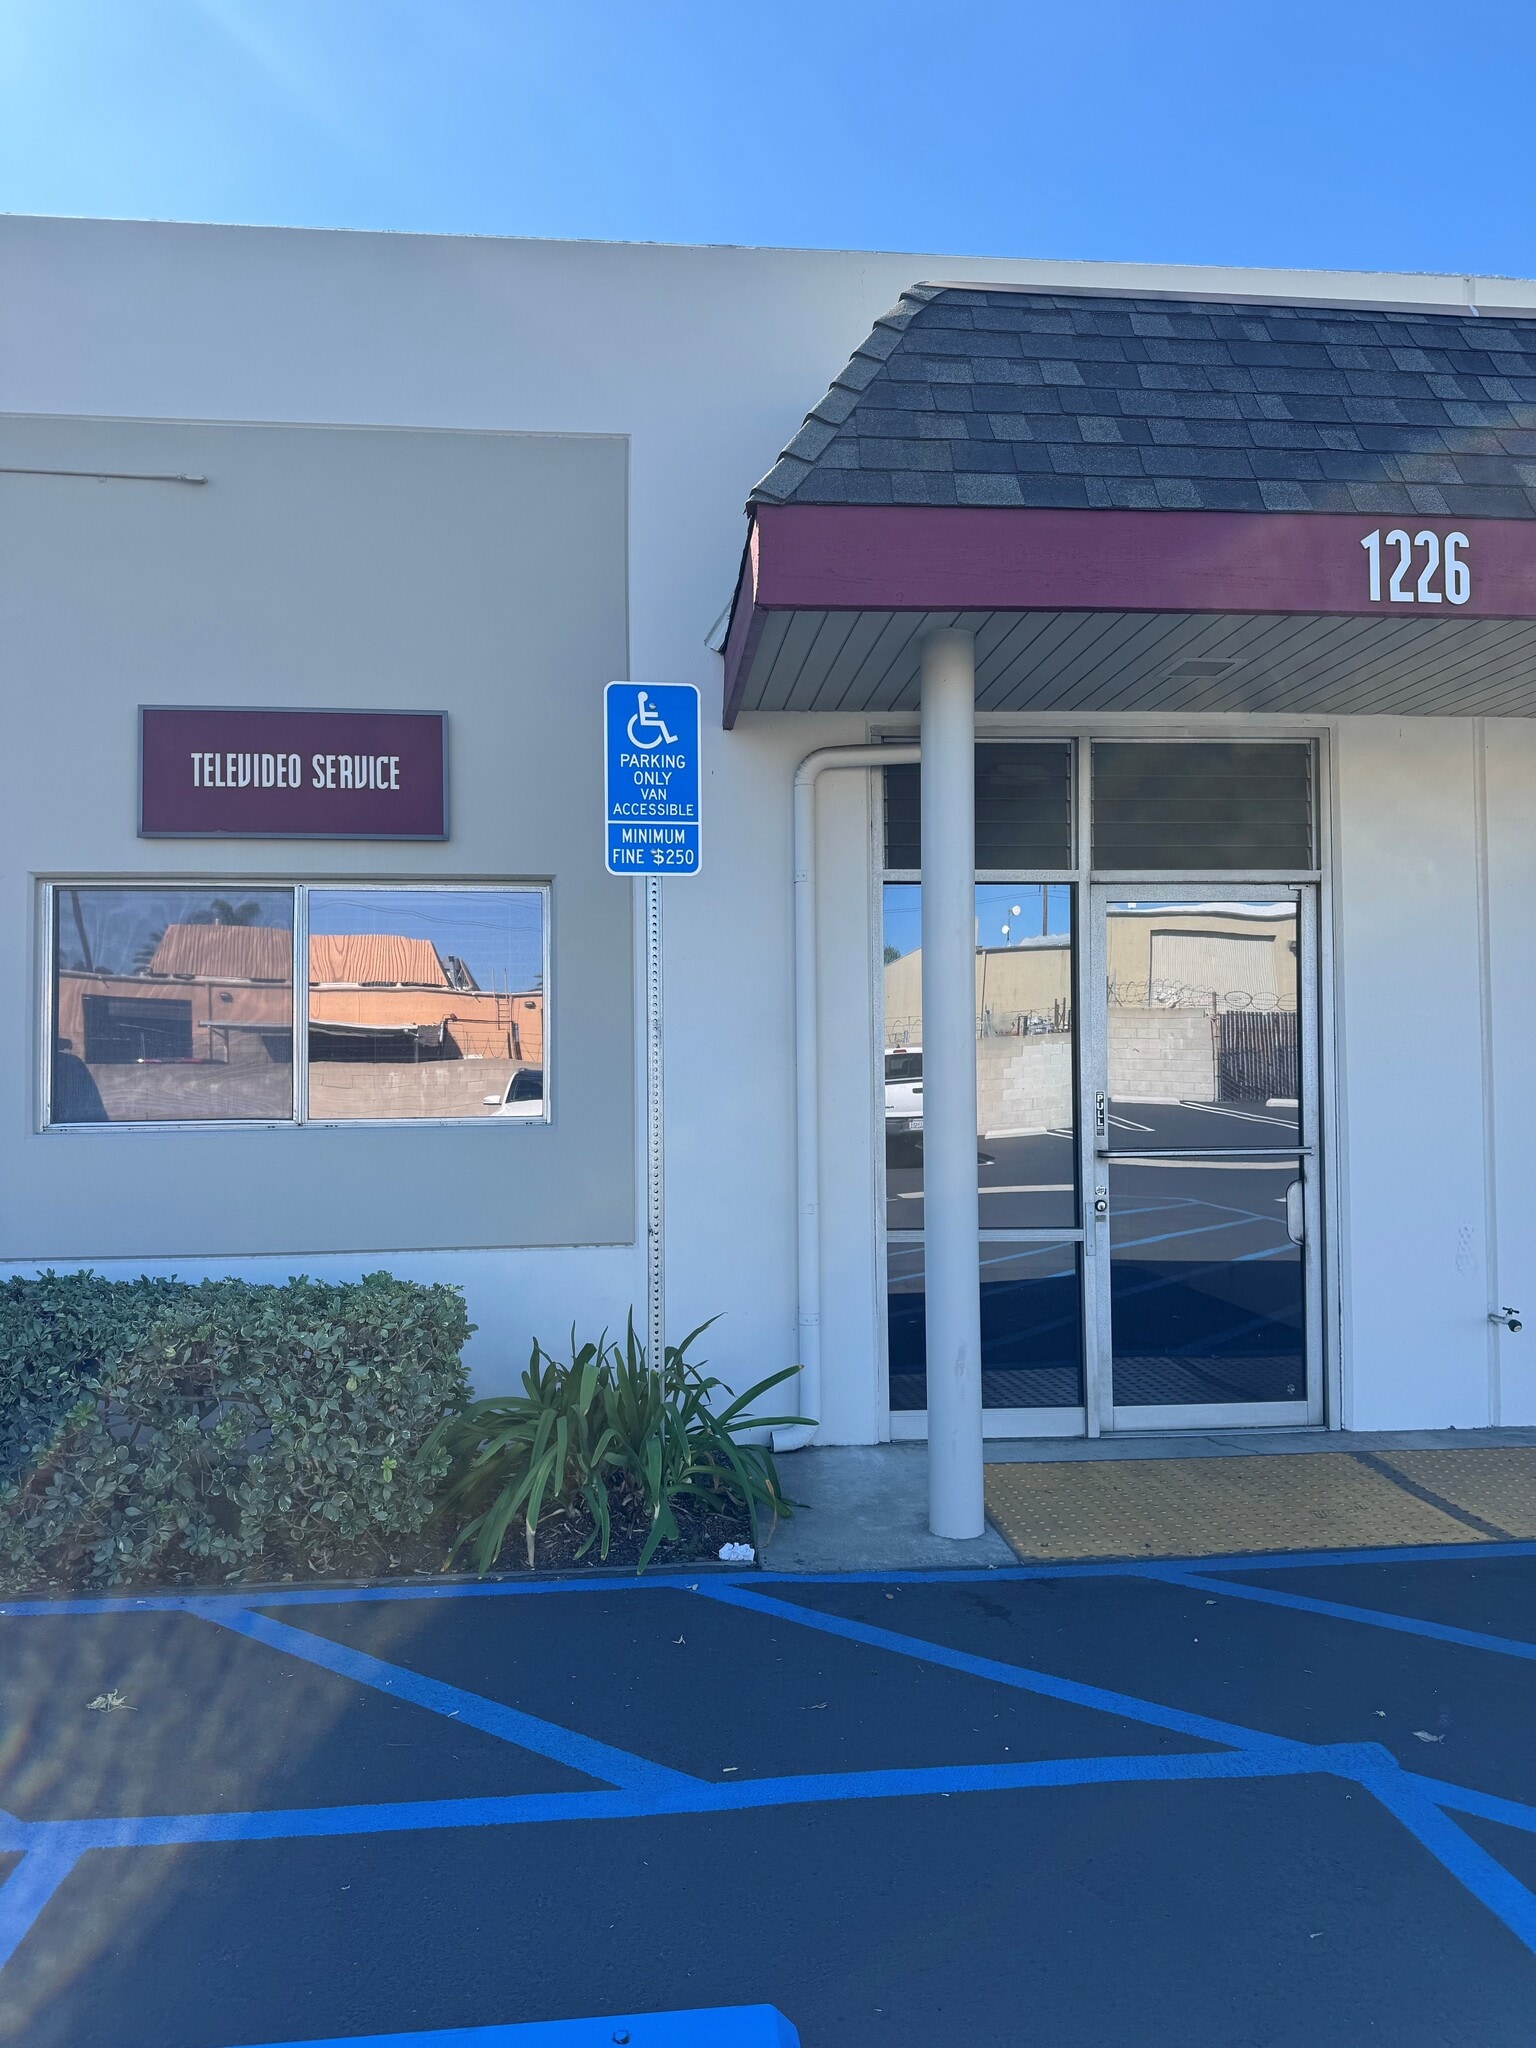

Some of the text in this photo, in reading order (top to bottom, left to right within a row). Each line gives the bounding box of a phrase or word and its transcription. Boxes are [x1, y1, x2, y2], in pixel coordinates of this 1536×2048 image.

[1360, 529, 1471, 605] 1226
[620, 753, 686, 769] PARKING
[190, 752, 400, 790] TELEVIDEO SERVICE
[633, 771, 672, 786] ONLY
[640, 788, 667, 801] VAN
[613, 803, 694, 817] ACCESSIBLE
[622, 828, 685, 844] MINIMUM
[613, 848, 694, 866] FINE $250
[1096, 1094, 1104, 1126] PULL
